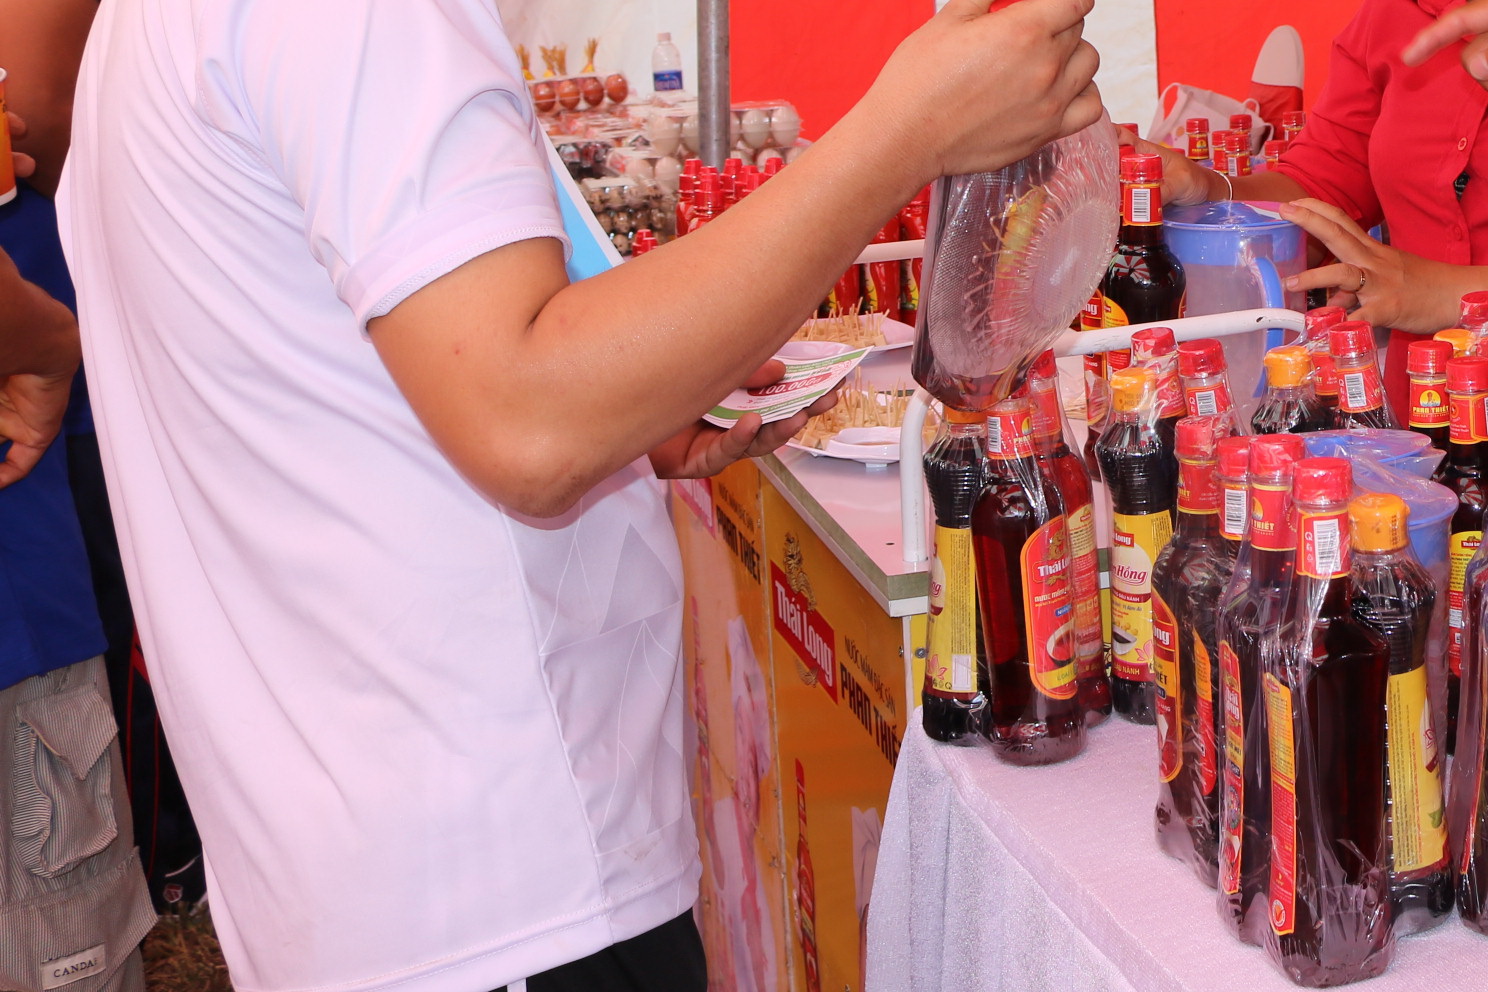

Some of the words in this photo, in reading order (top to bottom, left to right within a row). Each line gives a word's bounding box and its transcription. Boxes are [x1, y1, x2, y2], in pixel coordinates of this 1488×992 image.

[1253, 519, 1275, 531] THIẾT
[1115, 534, 1132, 545] Long
[739, 530, 762, 586] THIẾT
[1037, 559, 1062, 577] Thái
[1116, 563, 1147, 583] Hồng
[775, 580, 802, 641] Thái
[803, 610, 833, 686] Long
[1152, 629, 1170, 646] ong
[839, 662, 873, 736] PHAN
[873, 704, 902, 770] THIẾ
